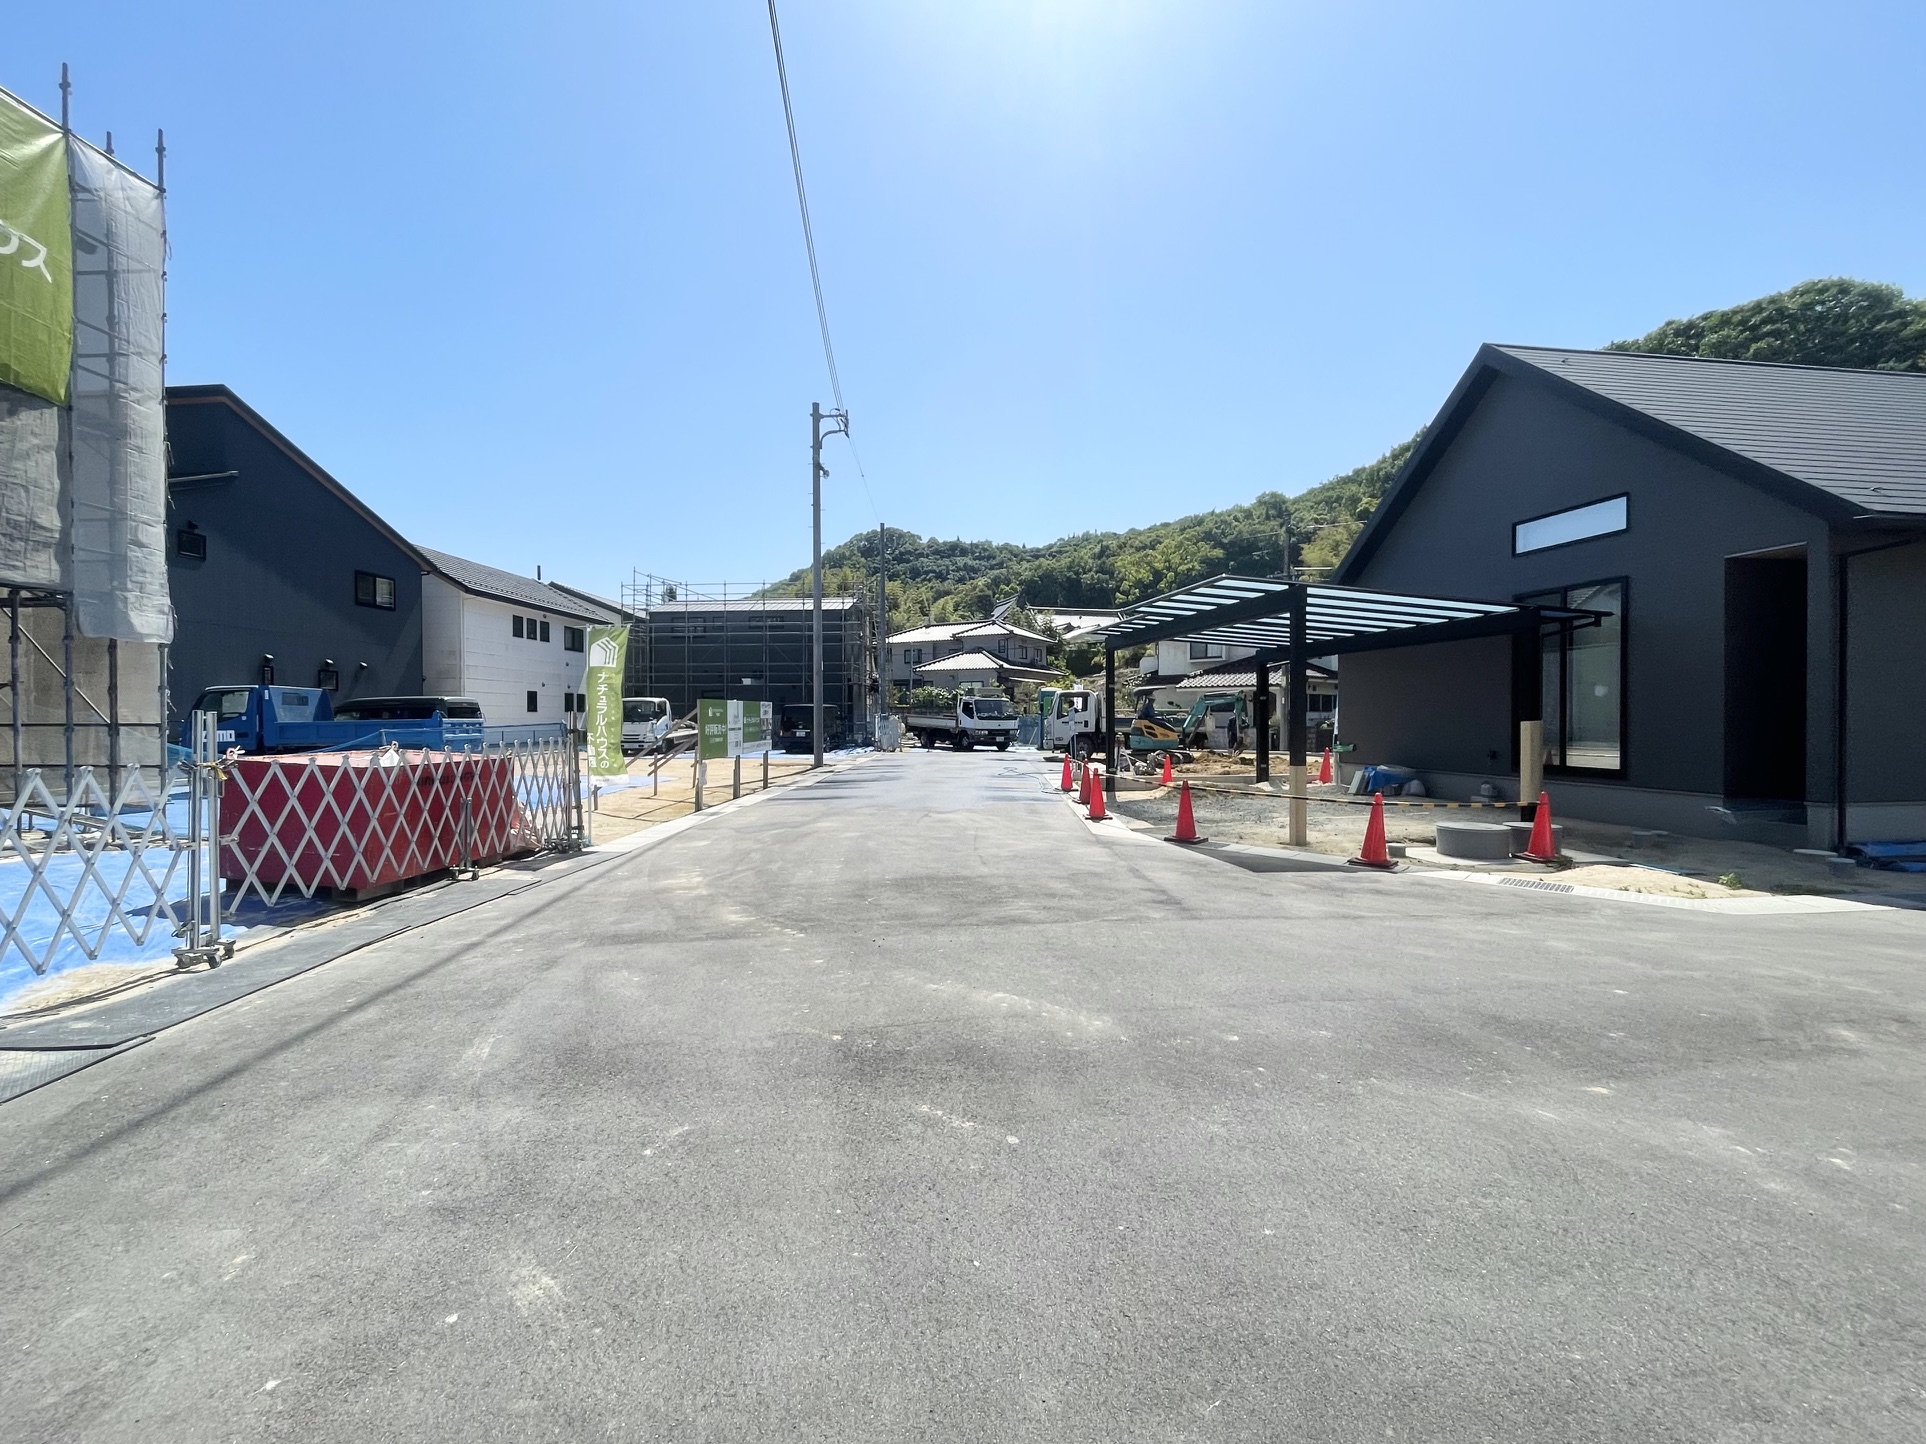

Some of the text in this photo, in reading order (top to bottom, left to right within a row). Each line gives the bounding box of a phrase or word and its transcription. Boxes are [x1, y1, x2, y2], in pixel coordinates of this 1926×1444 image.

[596, 672, 609, 768] ナチュラルハウスの
